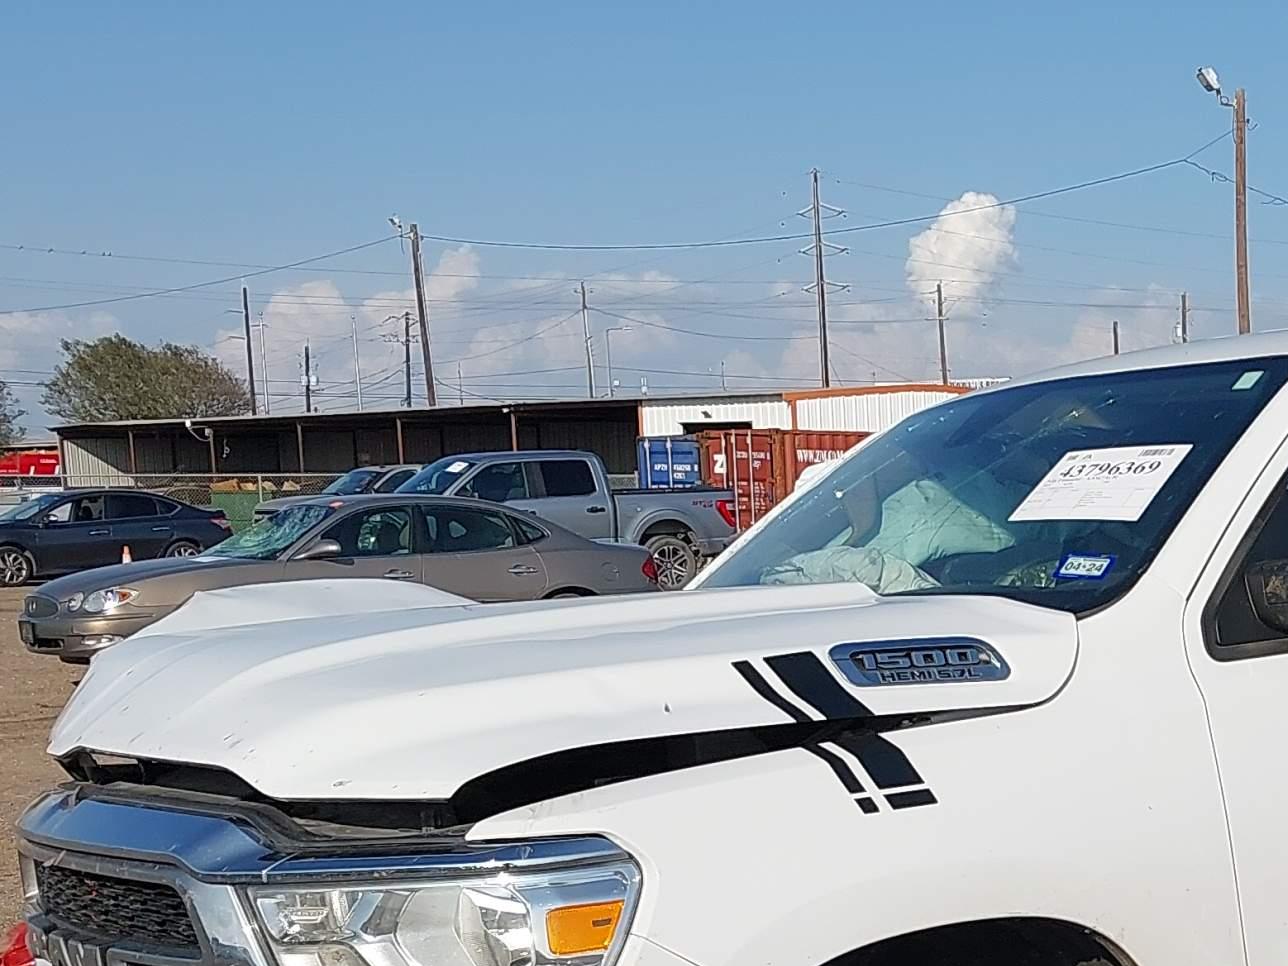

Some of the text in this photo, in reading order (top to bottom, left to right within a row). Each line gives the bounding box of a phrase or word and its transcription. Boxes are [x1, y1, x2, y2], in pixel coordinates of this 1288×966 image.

[1060, 460, 1162, 478] 43796369
[857, 648, 980, 671] 1500
[879, 670, 933, 684] HEMI
